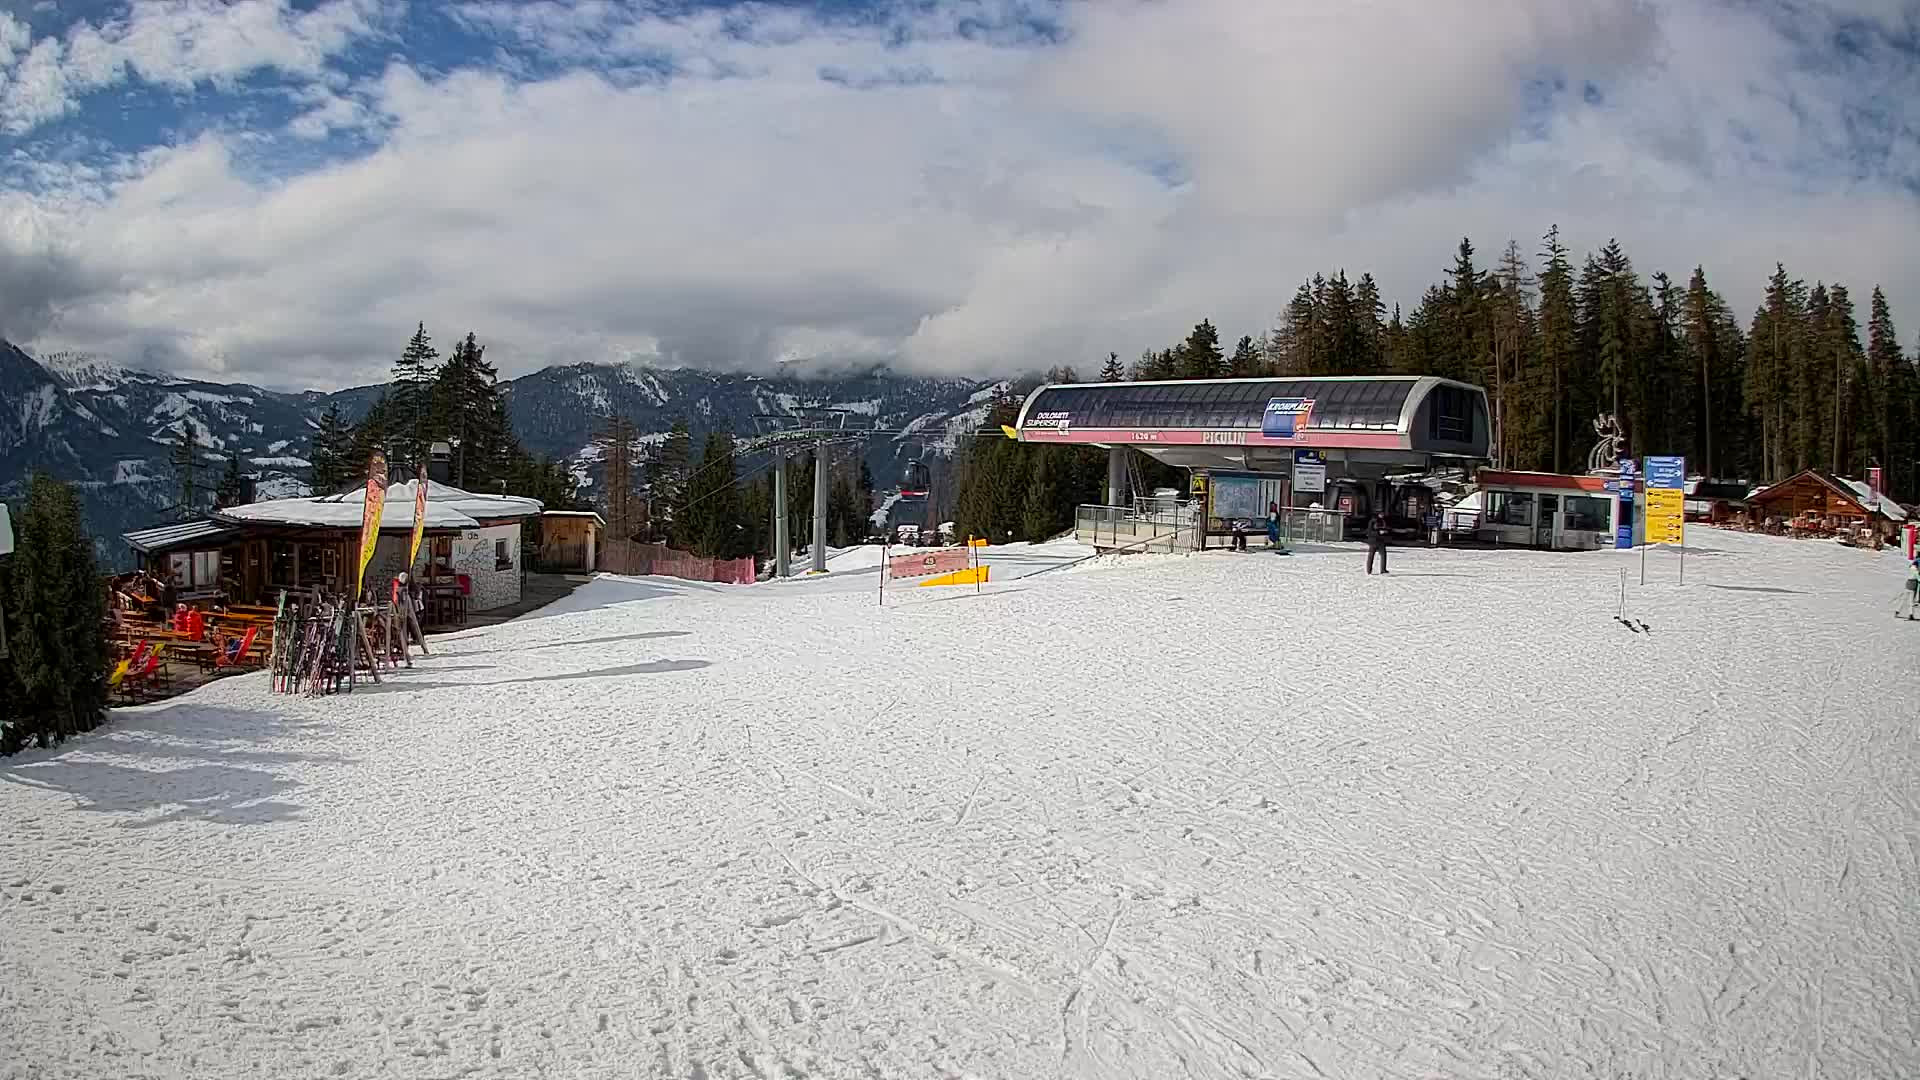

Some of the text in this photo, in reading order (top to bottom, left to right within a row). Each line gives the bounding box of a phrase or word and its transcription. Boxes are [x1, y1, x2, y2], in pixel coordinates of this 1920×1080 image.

[1037, 411, 1069, 419] DOLOMITI
[1026, 419, 1059, 427] SUPERSKI
[1202, 431, 1247, 445] PICULIN
